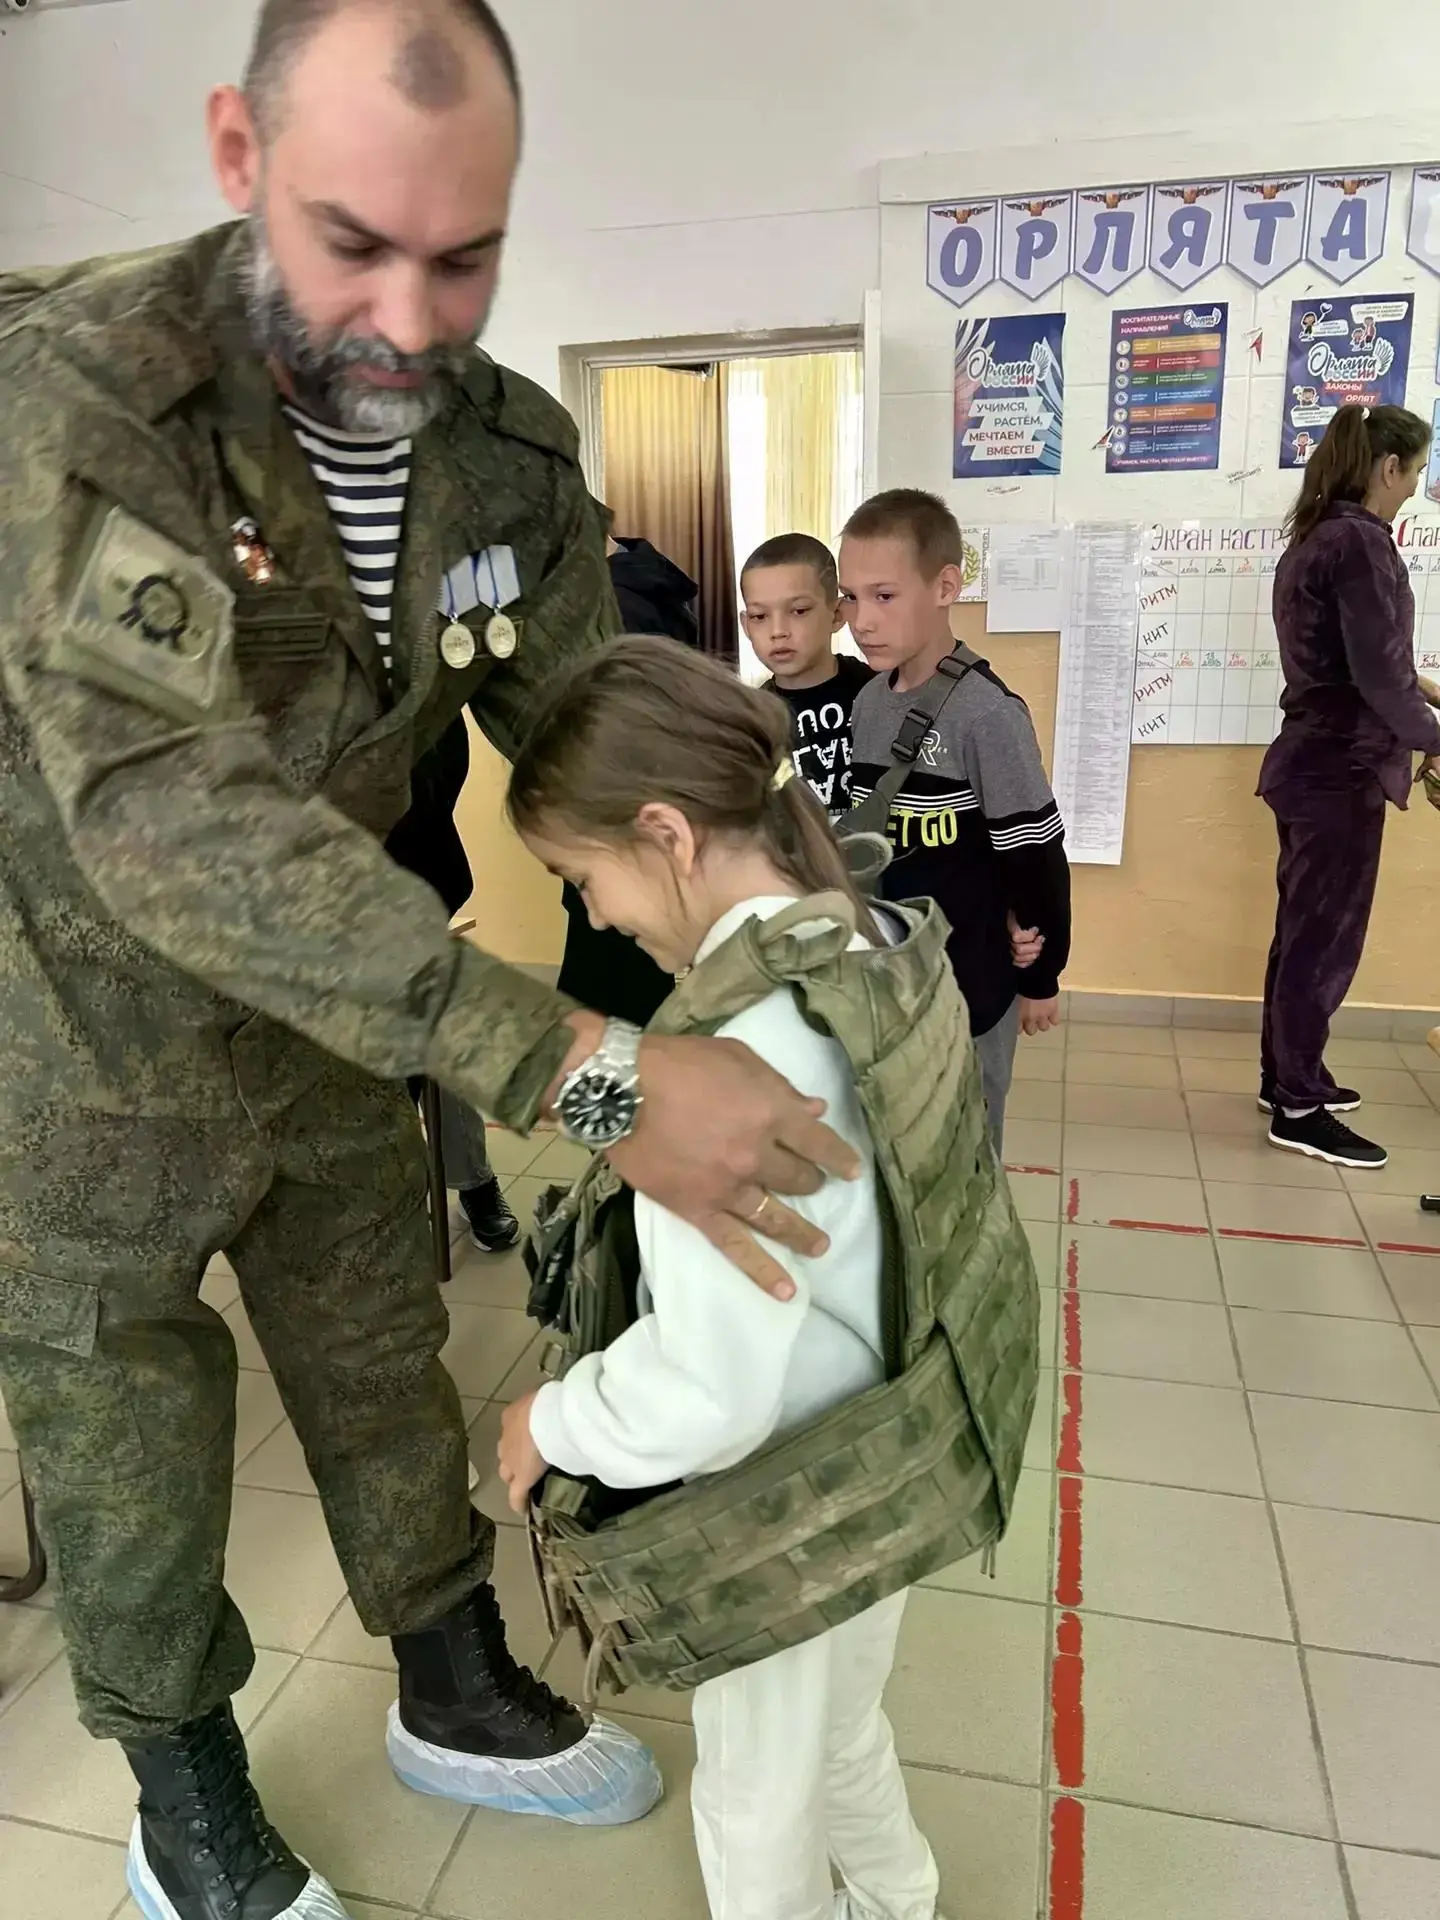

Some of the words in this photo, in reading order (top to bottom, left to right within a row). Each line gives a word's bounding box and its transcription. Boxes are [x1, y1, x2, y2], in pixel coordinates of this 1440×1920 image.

[939, 198, 1369, 288] ОРЛЯТА
[968, 349, 1036, 382] Орлята
[1309, 344, 1377, 376] Орлята
[1324, 382, 1363, 391] ЗАКОНЫ
[1345, 394, 1376, 403] ОРЛЯТ
[976, 401, 1028, 413] УЧИМСЯ,
[969, 430, 1025, 442] МЕЧТАЕМ
[986, 444, 1035, 456] ВМЕСТЕ!
[921, 807, 958, 848] GO
